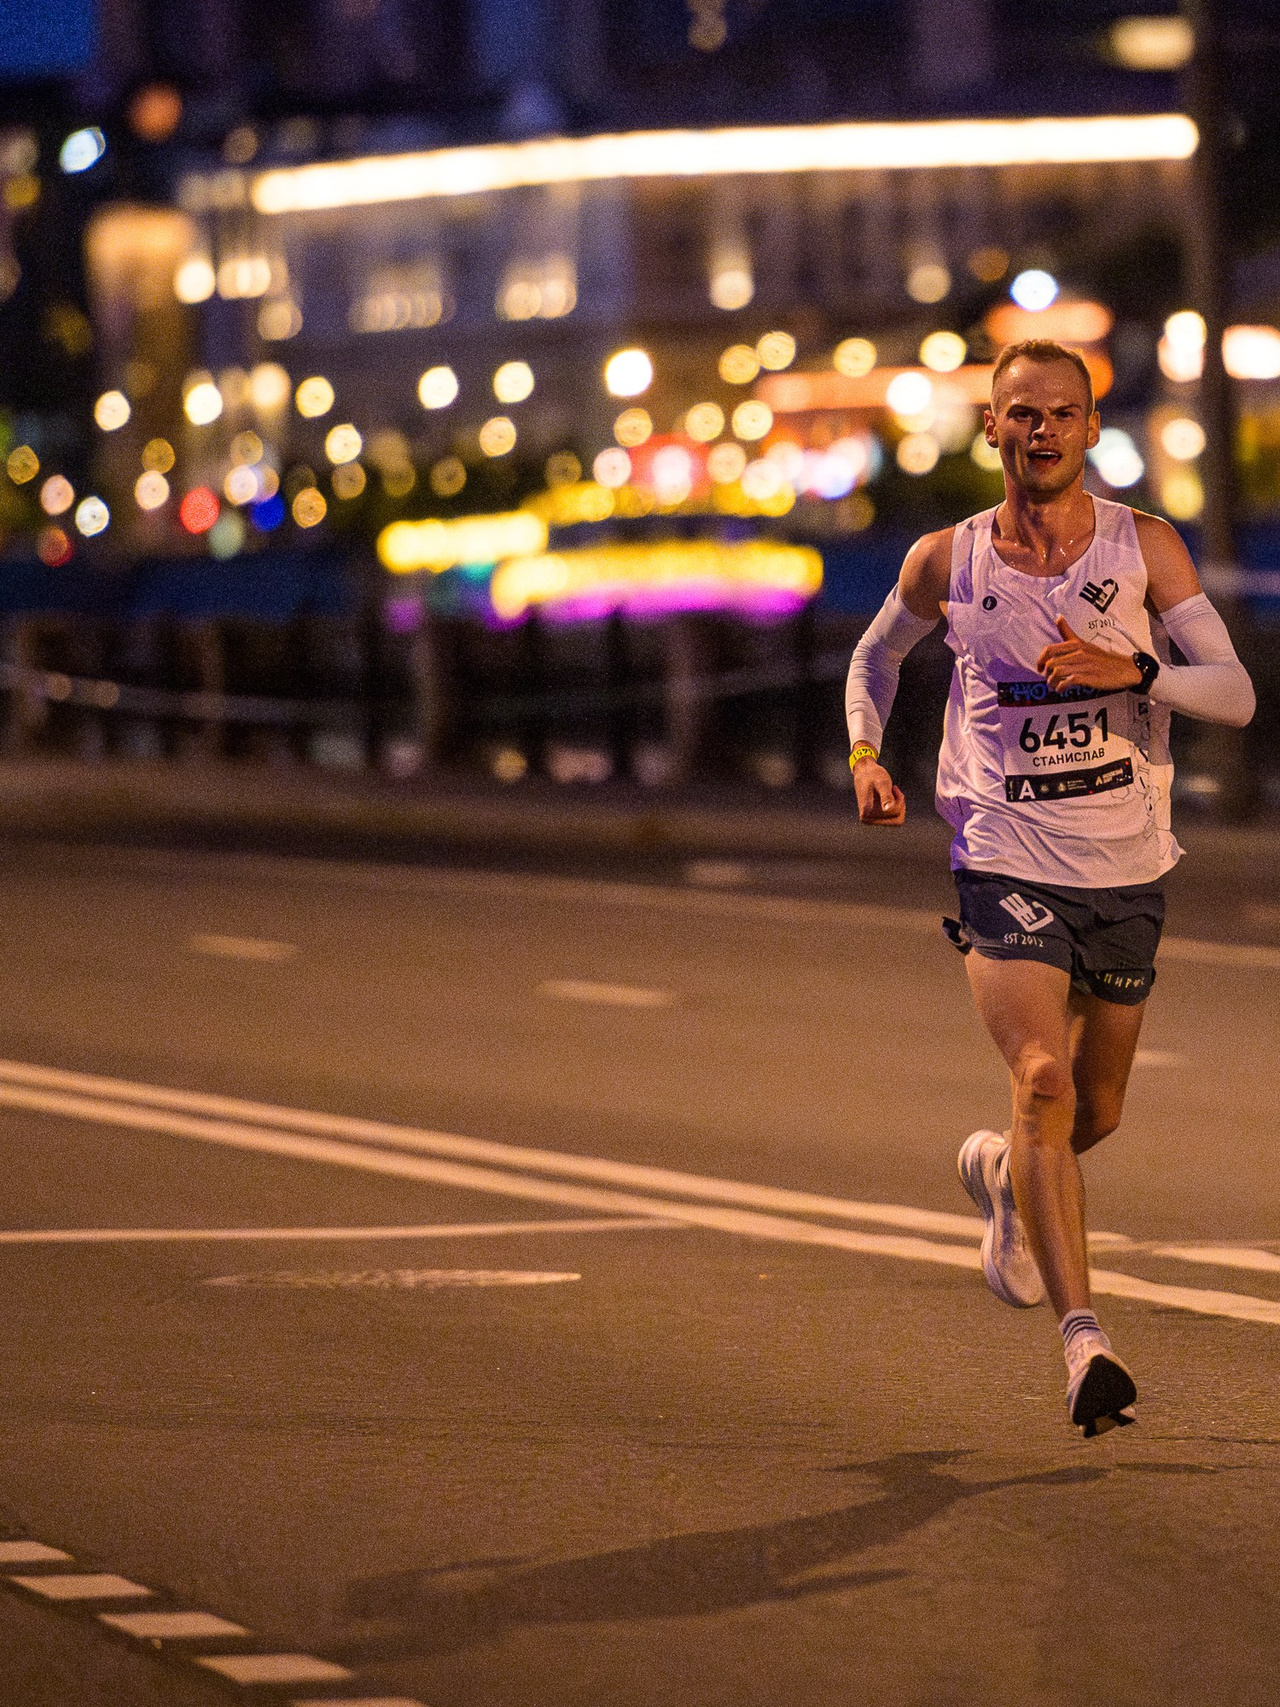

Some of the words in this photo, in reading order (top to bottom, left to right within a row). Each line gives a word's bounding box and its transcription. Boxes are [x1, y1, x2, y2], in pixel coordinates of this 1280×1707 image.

[1019, 707, 1108, 753] 6451
[1032, 747, 1105, 767] СТАНИСЛАВ
[1003, 932, 1018, 944] EST
[1020, 934, 1044, 948] 2012
